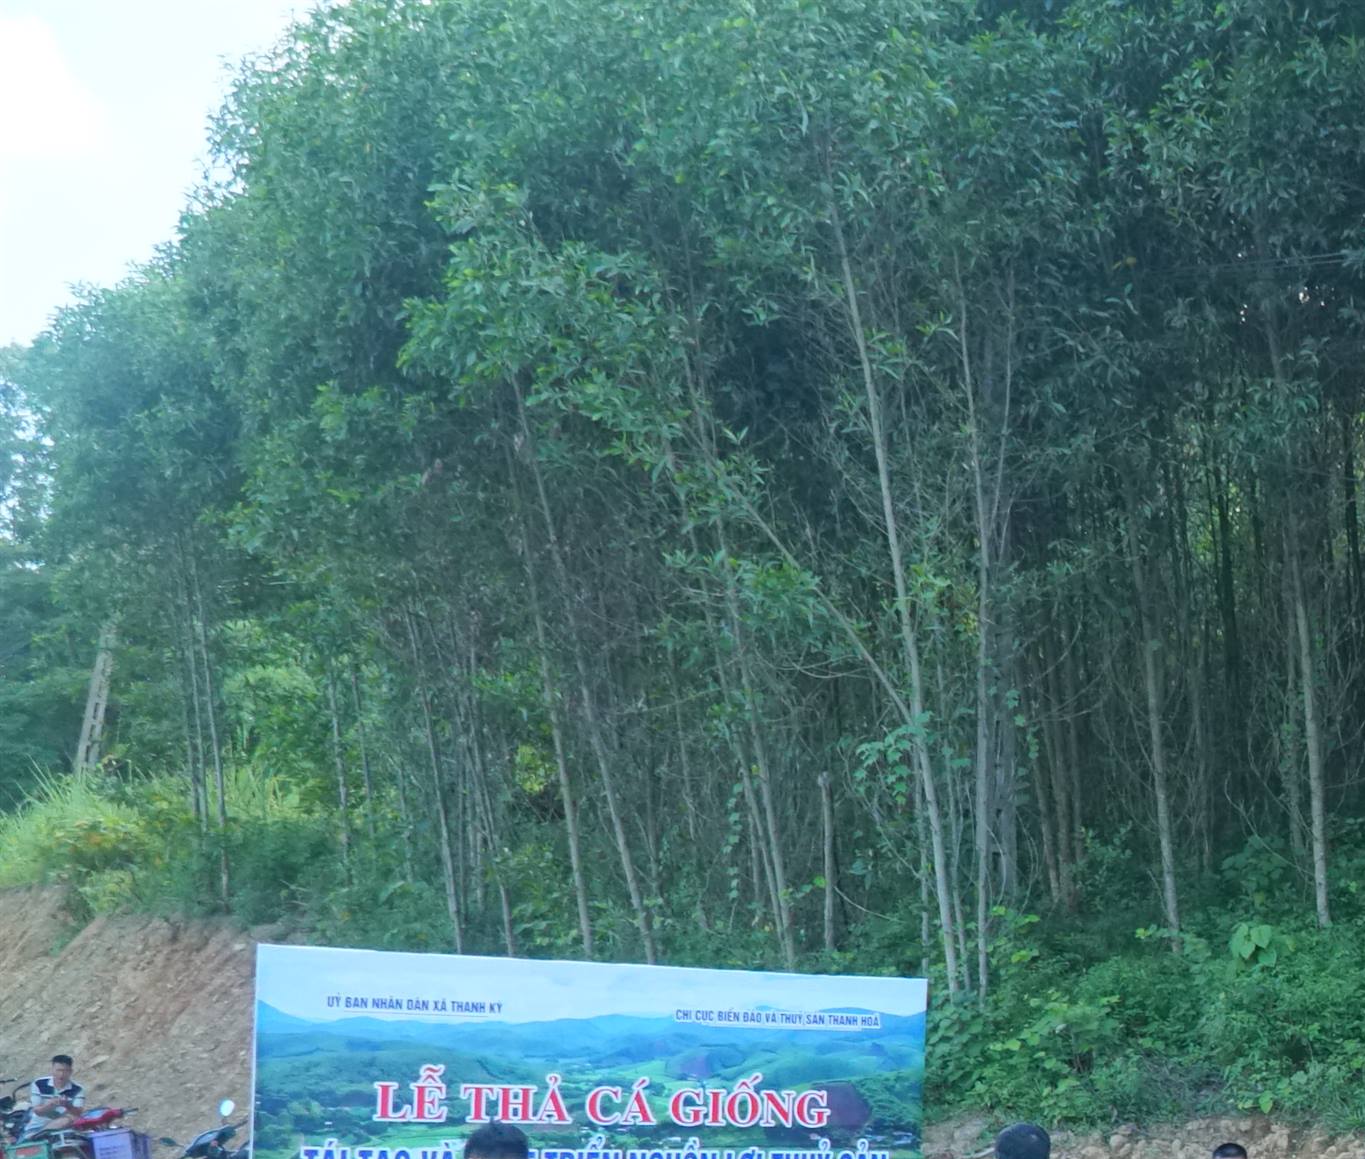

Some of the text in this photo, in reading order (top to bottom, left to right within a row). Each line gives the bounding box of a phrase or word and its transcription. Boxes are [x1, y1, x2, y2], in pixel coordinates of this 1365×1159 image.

[345, 996, 368, 1009] BAN
[451, 1000, 486, 1013] THANH
[828, 1014, 858, 1026] THANH
[374, 1064, 830, 1129] LỄ THẢ CÁ GIỐNG
